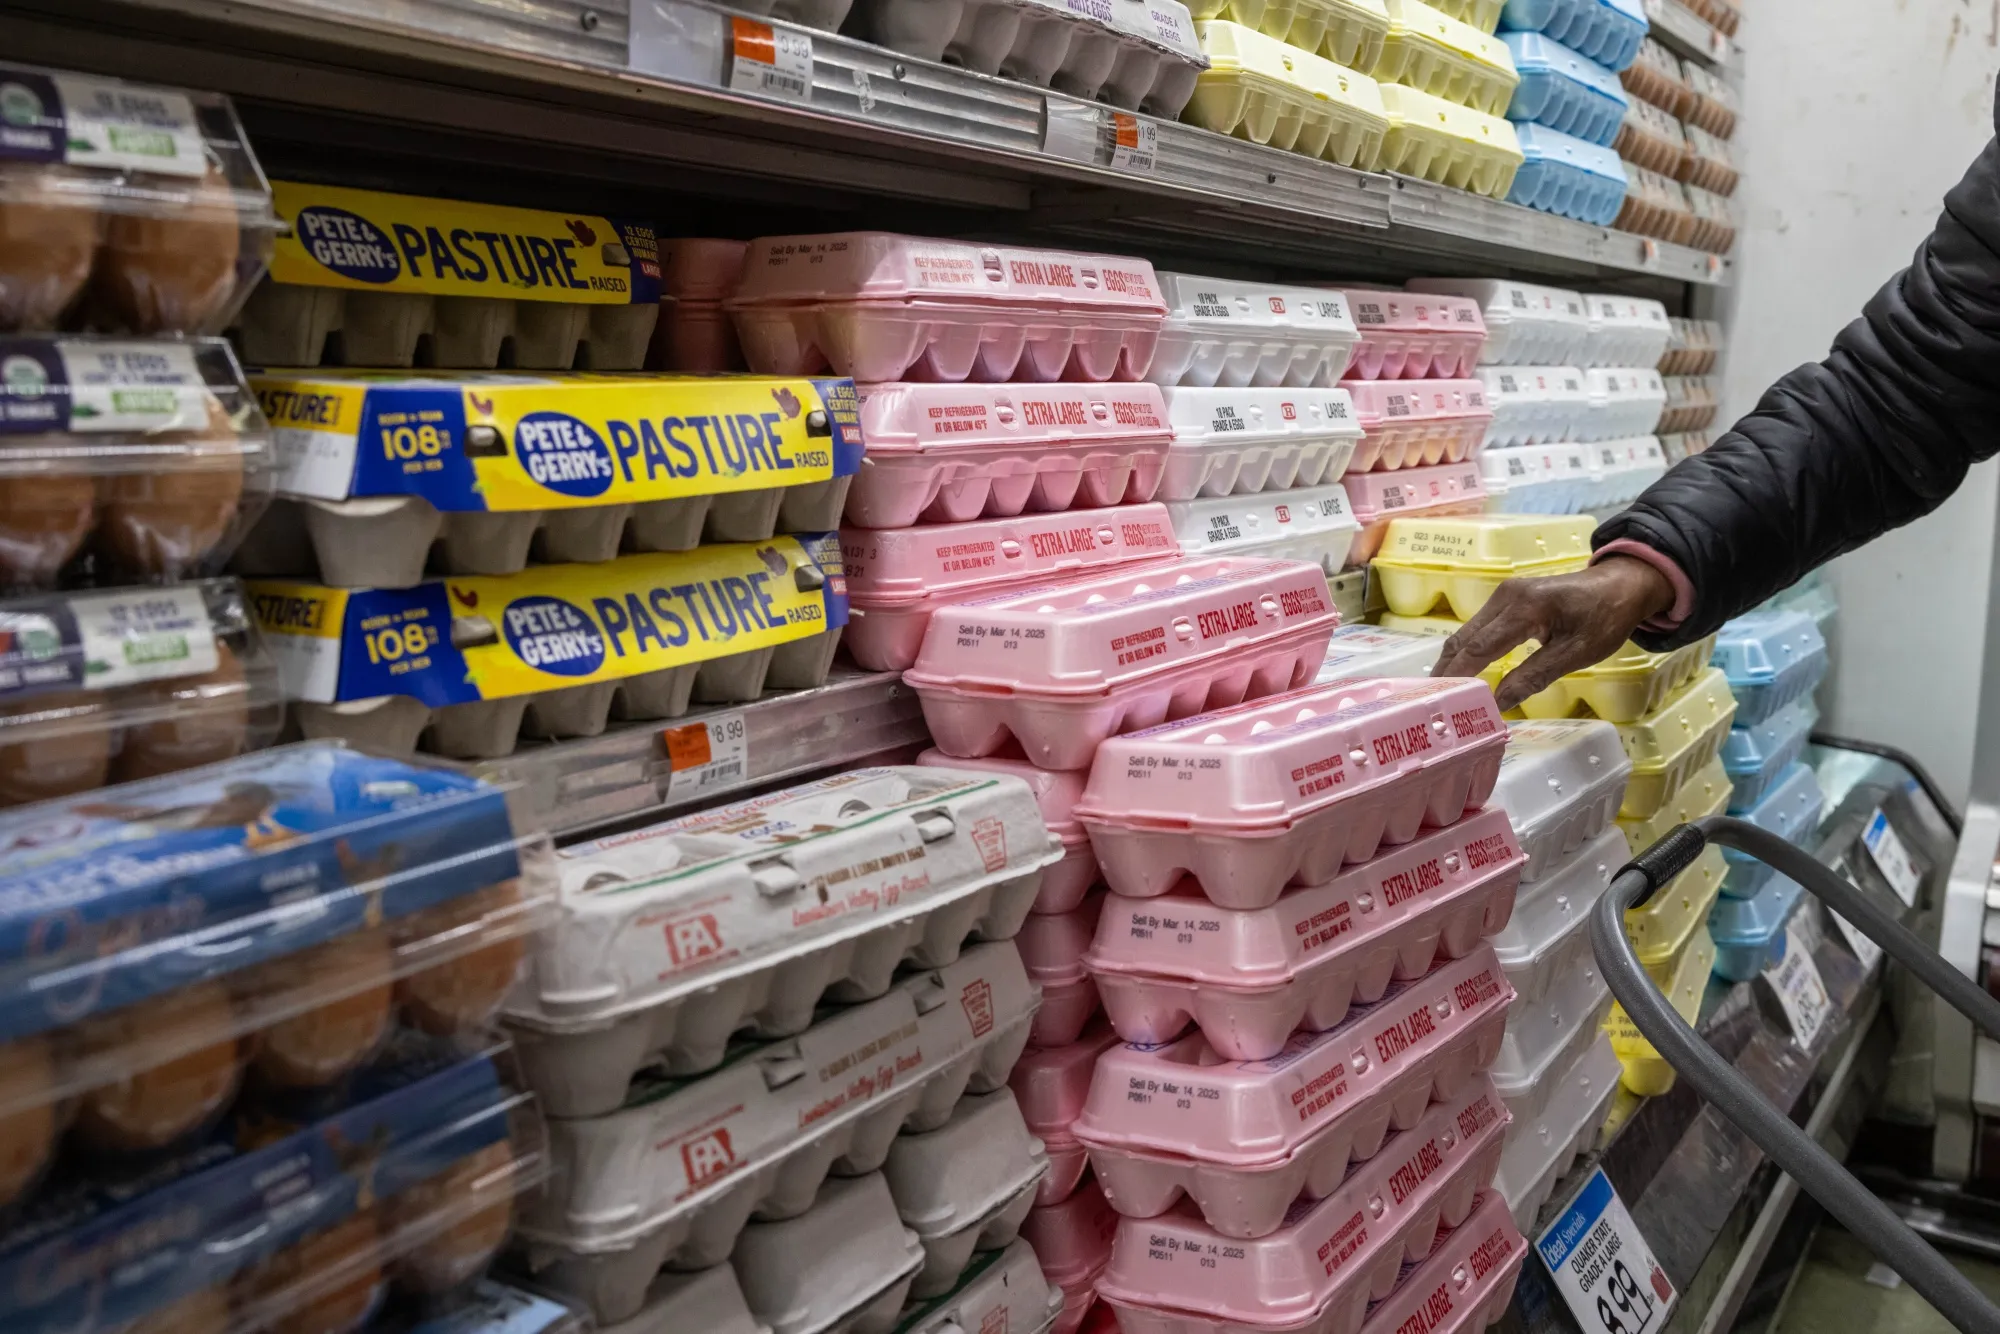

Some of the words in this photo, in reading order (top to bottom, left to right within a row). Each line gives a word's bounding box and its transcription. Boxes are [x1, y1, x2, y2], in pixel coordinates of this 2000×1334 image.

[1091, 2, 1113, 22] EGGS
[1151, 10, 1174, 26] GRADE
[1173, 19, 1179, 29] A
[1165, 30, 1181, 42] EGGS
[1146, 126, 1156, 140] 99
[303, 212, 357, 242] PETE
[360, 221, 376, 241] &
[392, 223, 590, 290] PASTURE
[591, 276, 628, 294] RAISED
[1010, 260, 1044, 285] EXTRA
[1044, 264, 1076, 288] LARGE
[1102, 269, 1126, 293] EGGS
[1205, 293, 1219, 305] PACK
[1317, 301, 1342, 319] LARGE
[1193, 305, 1211, 317] GRADE
[1216, 306, 1229, 317] EGGS
[928, 407, 943, 418] KEEP
[943, 405, 987, 418] REFRIGERATED
[1023, 402, 1055, 426] EXTRA
[1056, 401, 1087, 426] LARGE
[1113, 401, 1135, 424] EGGS
[1222, 406, 1236, 418] PACK
[1325, 402, 1347, 419] LARGE
[518, 421, 576, 452] PETE
[576, 424, 593, 446] &
[935, 421, 942, 433] AT
[943, 421, 952, 433] OR
[953, 420, 974, 433] BELOW
[1212, 420, 1229, 432] GRADE
[1232, 418, 1245, 431] EGGS
[381, 424, 441, 461] 108
[606, 413, 795, 482] PASTURE
[796, 450, 829, 468] RAISED
[1319, 498, 1343, 516] LARGE
[1217, 514, 1230, 528] PACK
[1032, 531, 1062, 558] EXTRA
[1062, 527, 1096, 554] LARGE
[1121, 524, 1144, 547] EGGS
[1207, 529, 1224, 543] GRADE
[1228, 526, 1240, 538] EGGS
[1433, 534, 1461, 545] PA131
[1467, 537, 1473, 546] 4
[1432, 546, 1453, 555] MAR
[1455, 549, 1466, 558] 14
[592, 571, 788, 657] PASTURE
[788, 604, 822, 623] RAISED
[1280, 590, 1302, 616] EGGS
[505, 603, 564, 638] PETE
[564, 607, 582, 627] &
[958, 625, 974, 635] Sell
[1024, 629, 1046, 639] 2025
[1197, 611, 1227, 639] EXTRA
[1227, 602, 1258, 632] LARGE
[364, 623, 428, 664] 108
[1003, 641, 1018, 650] 013
[1111, 638, 1125, 650] KEEP
[1126, 627, 1165, 648] REFRIGERATED
[1118, 654, 1125, 666] AT
[1126, 651, 1133, 664] OR
[1135, 646, 1154, 662] BELOW
[727, 720, 743, 740] 99
[1452, 710, 1474, 738] EGGS
[1372, 734, 1402, 766] EXTRA
[1401, 723, 1431, 758] LARGE
[1128, 756, 1145, 766] Sell
[1199, 759, 1221, 769] 2025
[1178, 771, 1192, 781] 013
[1465, 839, 1489, 870] EGGS
[1382, 872, 1413, 907] EXTRA
[1413, 859, 1444, 896] LARGE
[1132, 914, 1147, 925] Sell
[1199, 921, 1220, 933] 2025
[1296, 920, 1308, 935] KEEP
[1309, 902, 1349, 930] REFRIGERATED
[1178, 933, 1192, 944] 013
[1303, 939, 1311, 952] AT
[1312, 935, 1320, 948] OR
[1321, 925, 1340, 945] BELOW
[1454, 979, 1478, 1011] EGGS
[1375, 1026, 1407, 1063] EXTRA
[1404, 1005, 1436, 1047] LARGE
[1129, 1077, 1146, 1089] Sell
[1198, 1088, 1220, 1099] 2025
[1457, 1109, 1479, 1141] EGGS
[1389, 1167, 1419, 1205] EXTRA
[1413, 1138, 1443, 1179] LARGE
[1150, 1235, 1166, 1247] Sell
[1222, 1248, 1245, 1259] 2025
[1317, 1242, 1329, 1262] KEEP
[1329, 1211, 1364, 1251] REFRIGERATED
[1542, 1232, 1568, 1267] Ideal
[1562, 1211, 1586, 1245] Specials
[1571, 1240, 1598, 1275] QUAKER
[1594, 1218, 1612, 1245] STATE
[1200, 1258, 1215, 1268] 013
[1325, 1262, 1333, 1277] AT
[1334, 1257, 1341, 1271] OR
[1342, 1241, 1357, 1264] BELOW
[1469, 1251, 1492, 1281] EGGS
[1579, 1260, 1603, 1293] GRADE
[1606, 1231, 1623, 1262] LARGE
[1421, 1282, 1453, 1326] LARGE
